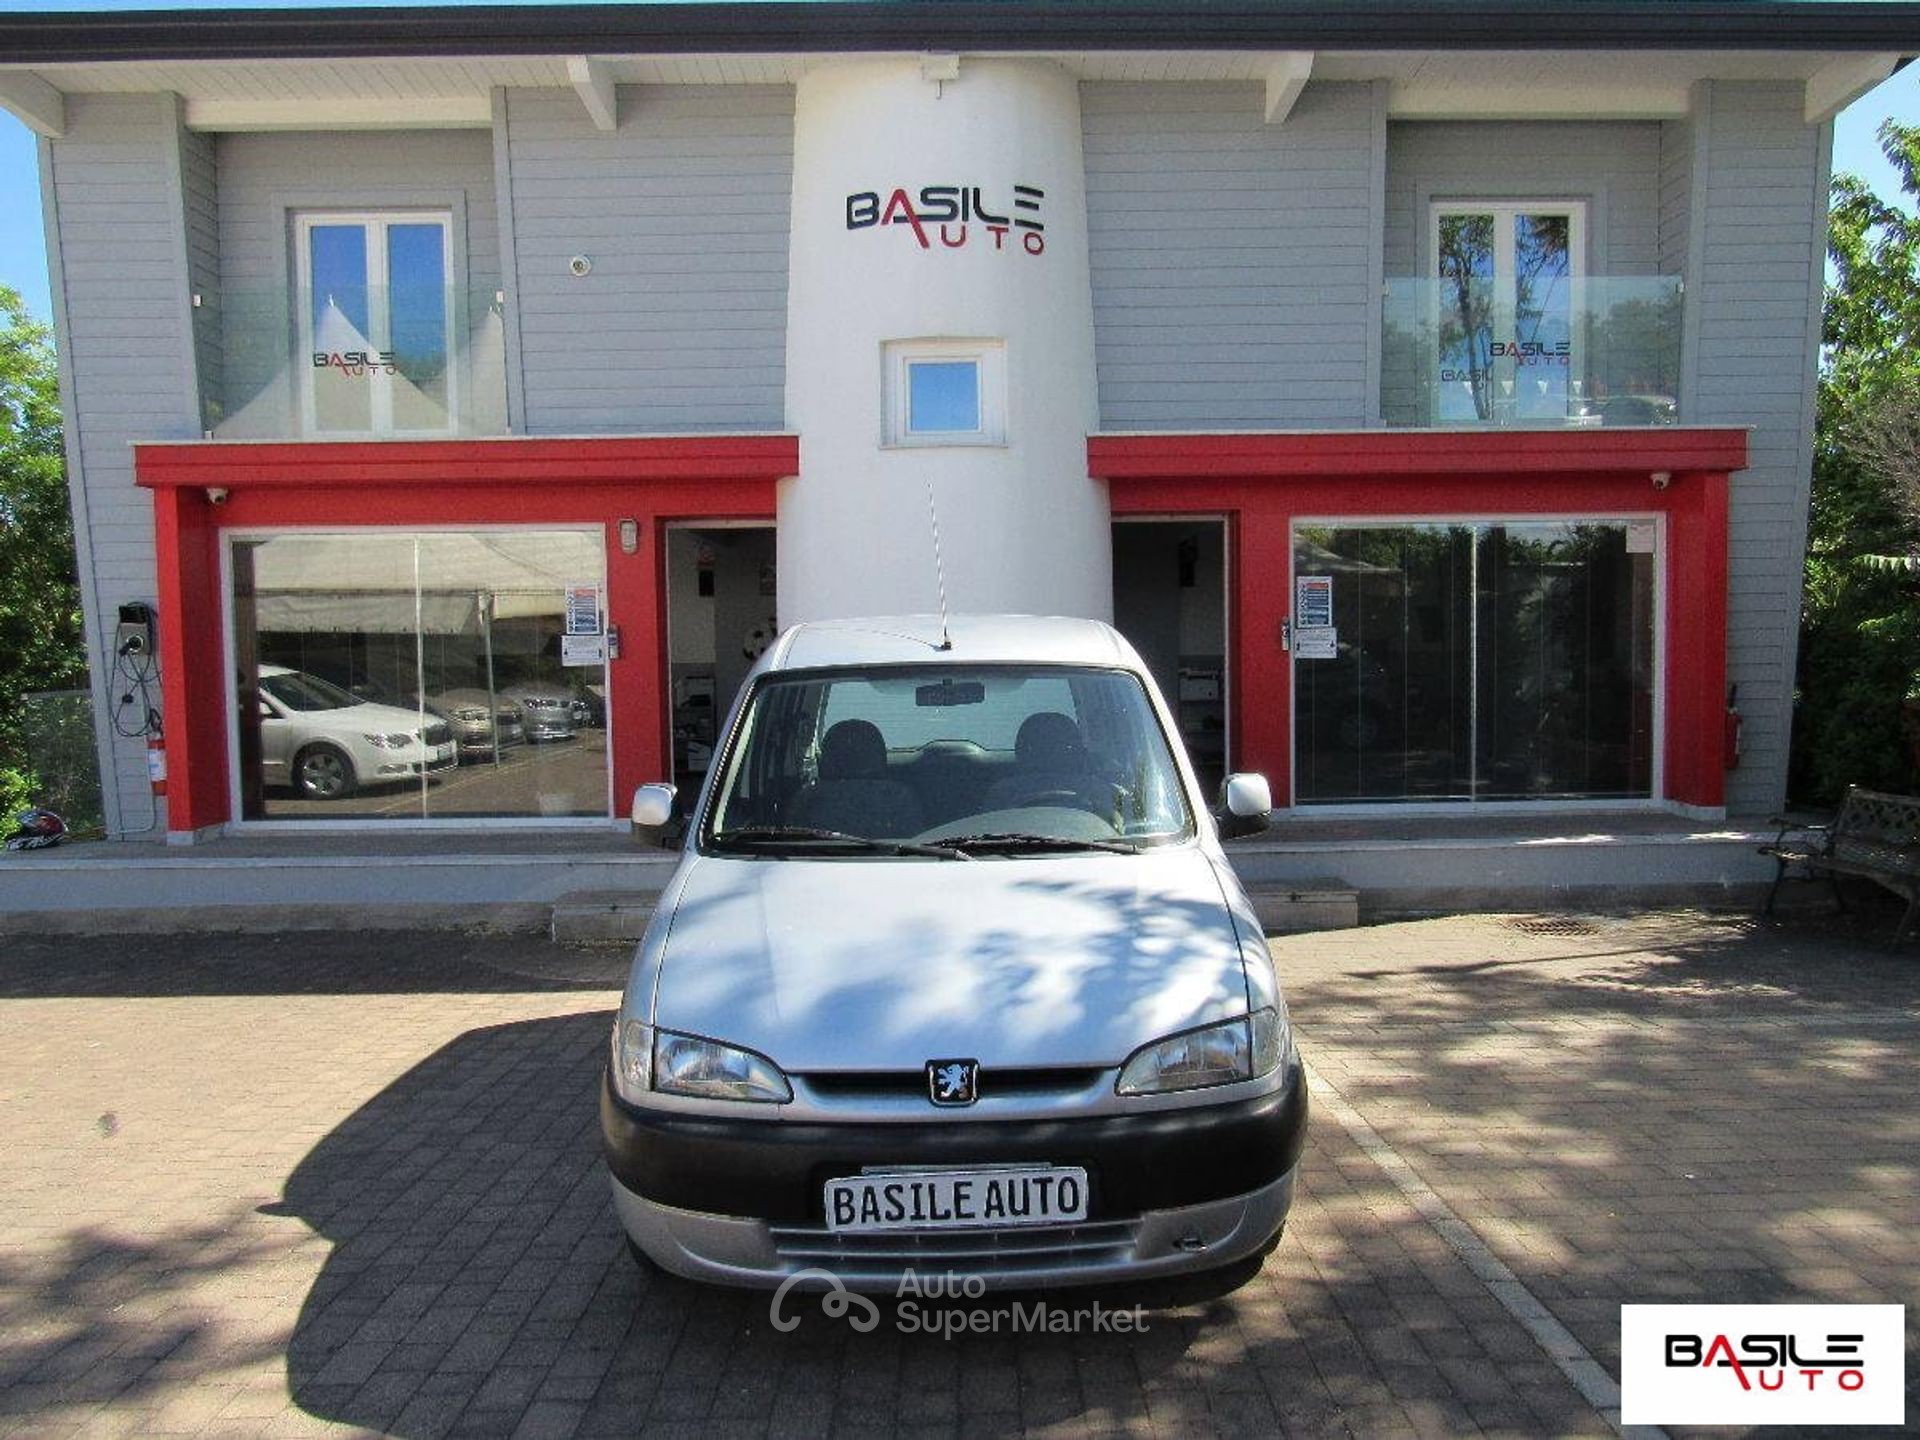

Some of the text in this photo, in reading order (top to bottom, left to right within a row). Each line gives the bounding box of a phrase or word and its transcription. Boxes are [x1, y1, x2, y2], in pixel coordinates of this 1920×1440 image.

[846, 185, 1045, 231] BASILE
[312, 351, 396, 367] BASILE
[1489, 342, 1571, 357] BASILE
[833, 1176, 1080, 1226] BASILE AUTO
